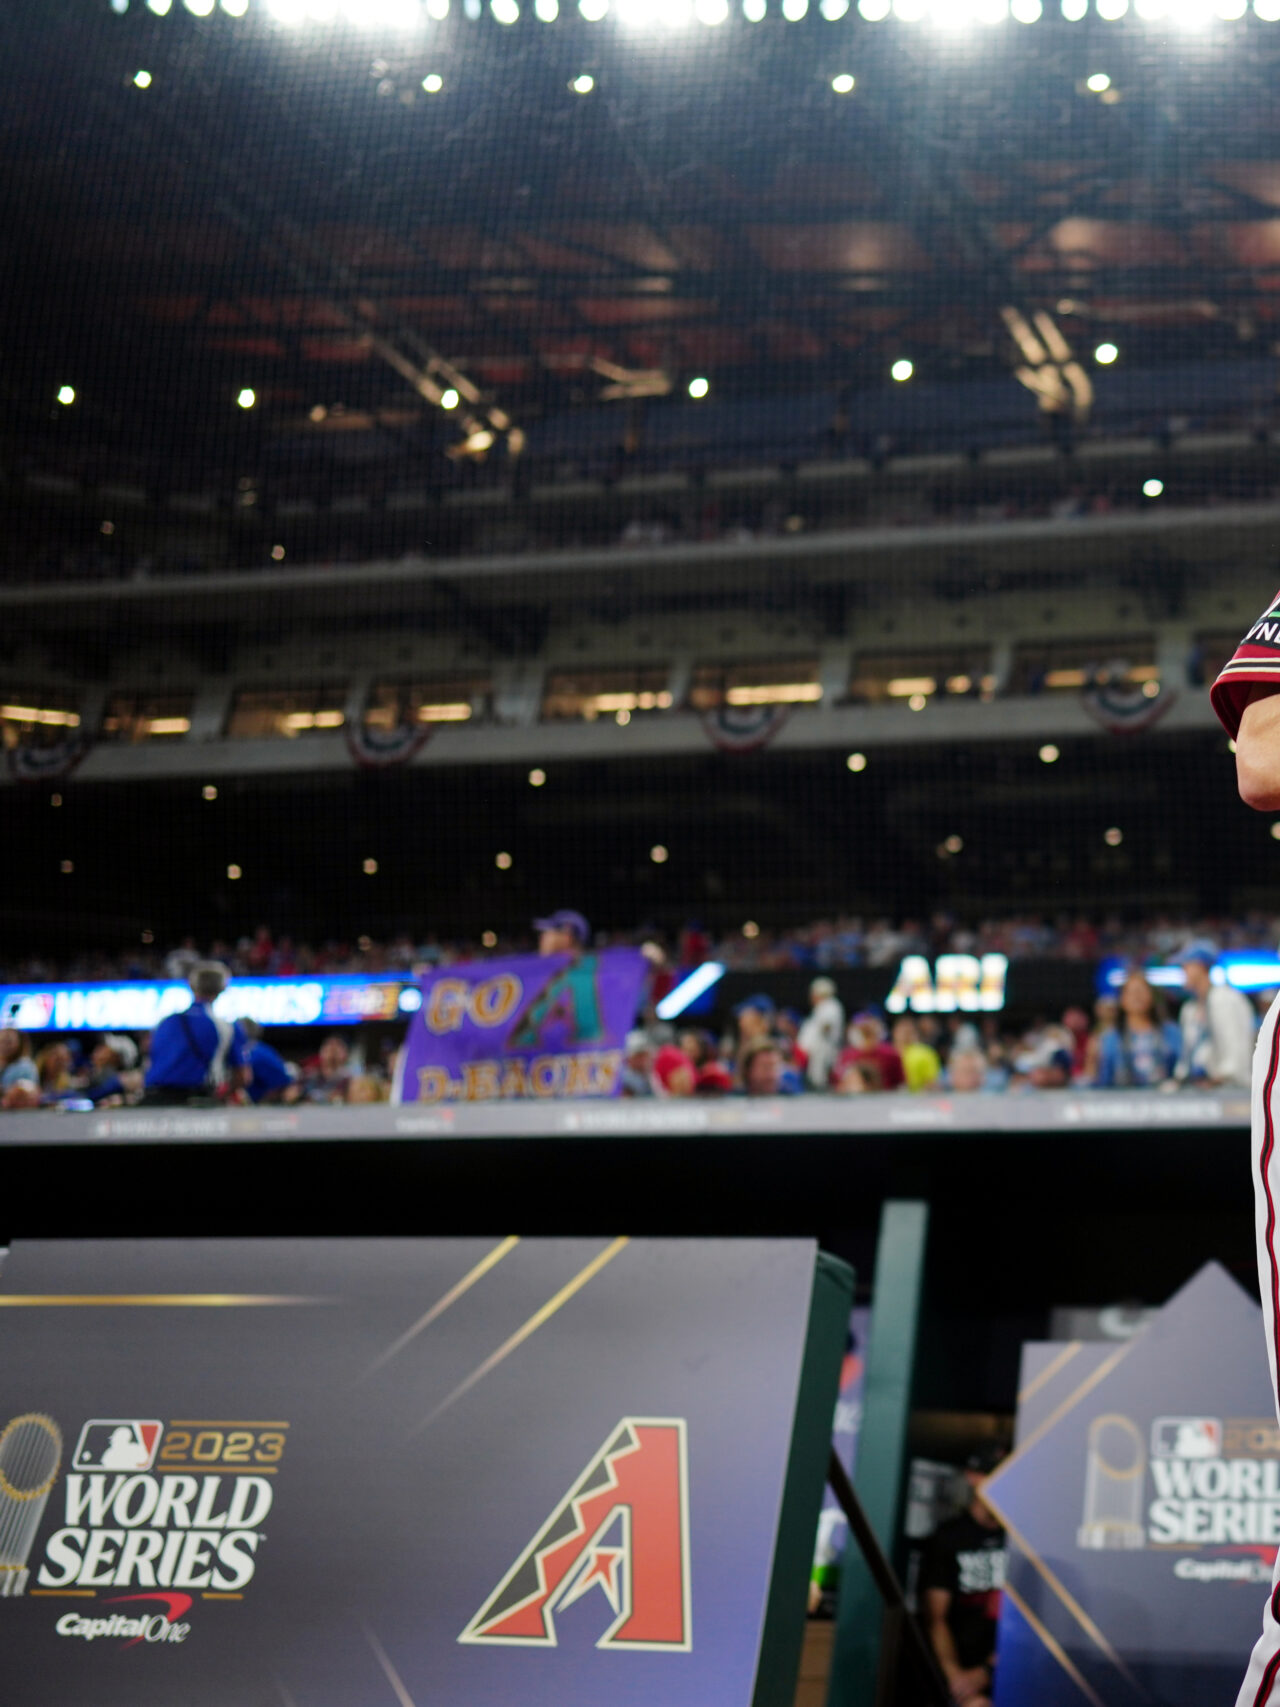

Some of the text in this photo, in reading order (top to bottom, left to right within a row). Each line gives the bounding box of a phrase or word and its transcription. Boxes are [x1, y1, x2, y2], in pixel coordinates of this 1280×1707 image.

[423, 967, 524, 1035] GO
[159, 1431, 287, 1463] 2023
[64, 1473, 274, 1529] WORLD
[37, 1527, 259, 1591] SERIES
